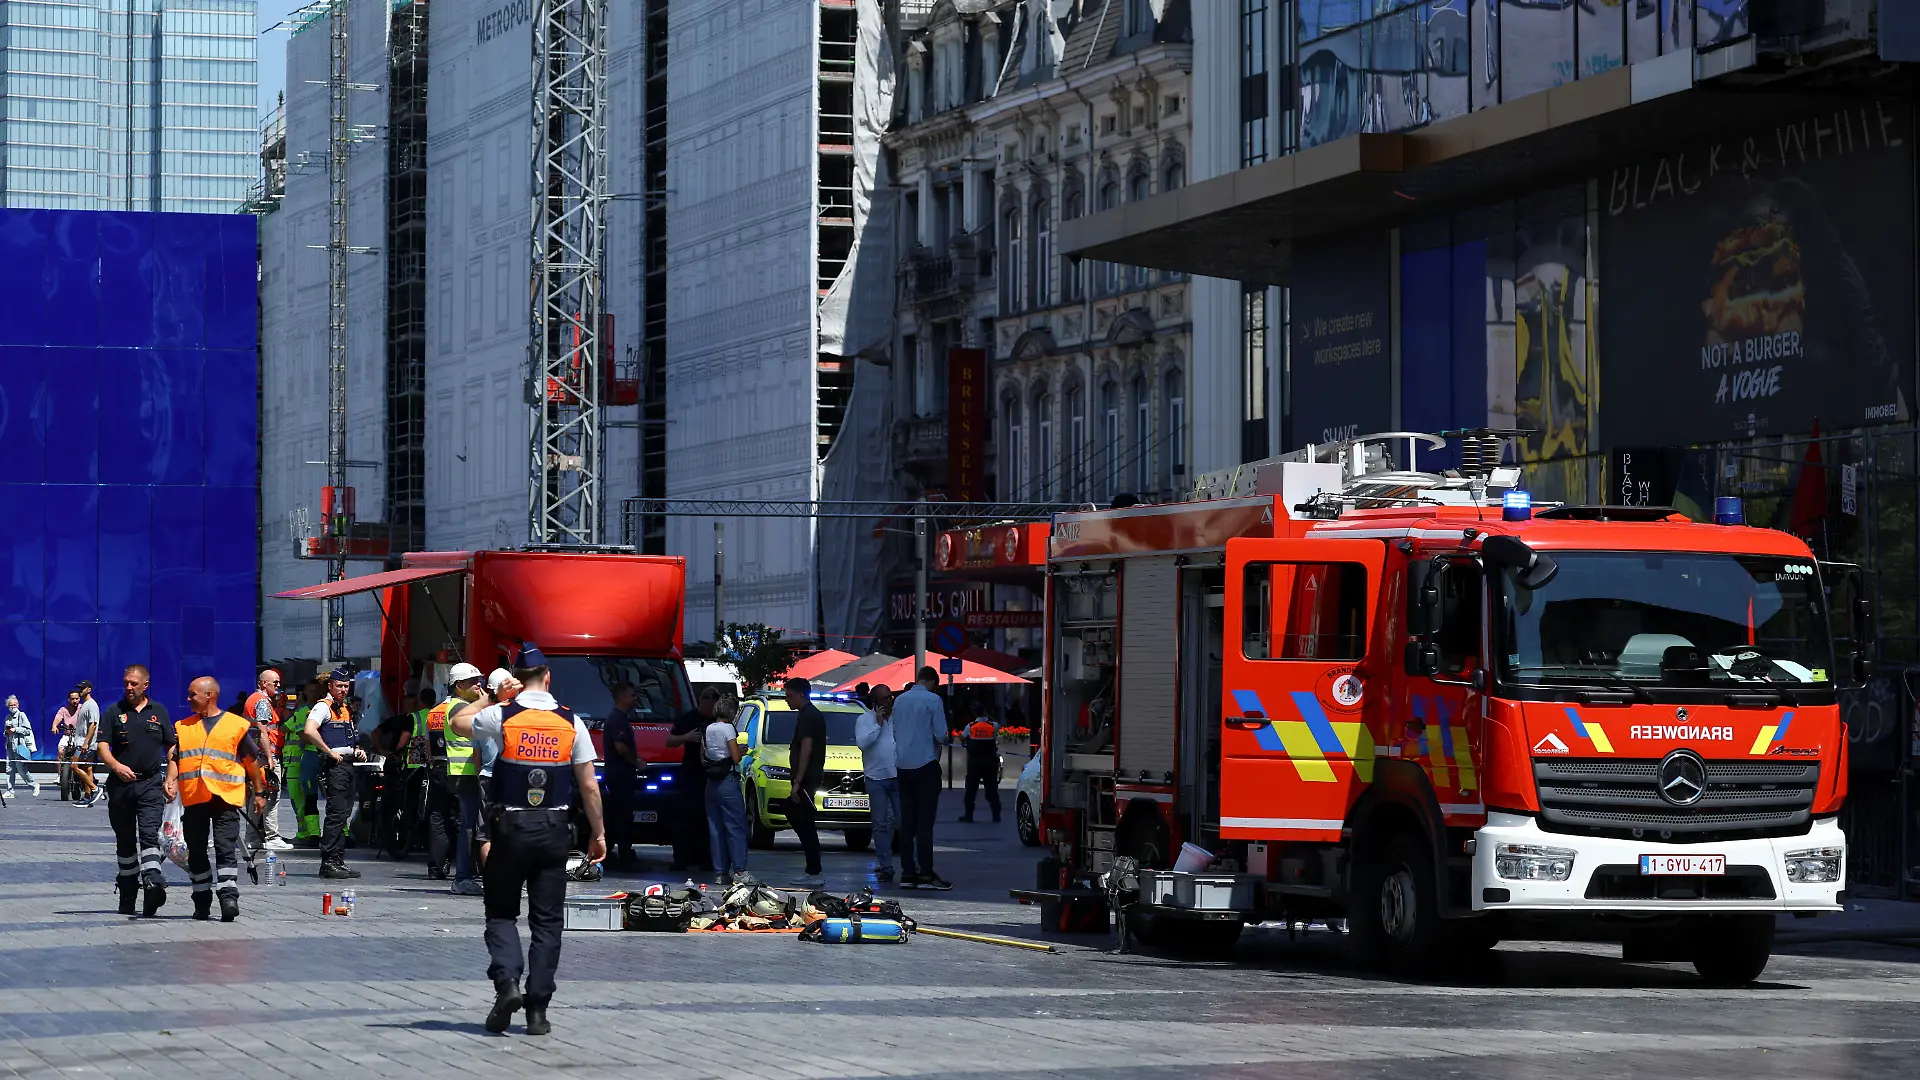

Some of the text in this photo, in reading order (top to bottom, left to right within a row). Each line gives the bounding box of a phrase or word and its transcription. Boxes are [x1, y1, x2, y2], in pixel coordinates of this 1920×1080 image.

[1609, 98, 1903, 216] BLACK & WHITE
[1314, 311, 1373, 337] We create new
[1314, 334, 1381, 366] workspaces here
[1702, 331, 1803, 369] NOT A BURGER,
[1715, 365, 1784, 404] A VOGUE
[1865, 403, 1898, 420] IMMOBEL
[961, 367, 973, 502] BRUSSELS
[1621, 453, 1633, 506] BLACK
[891, 586, 944, 620] BRUSELS
[517, 745, 560, 759] Politie
[521, 732, 559, 745] Police
